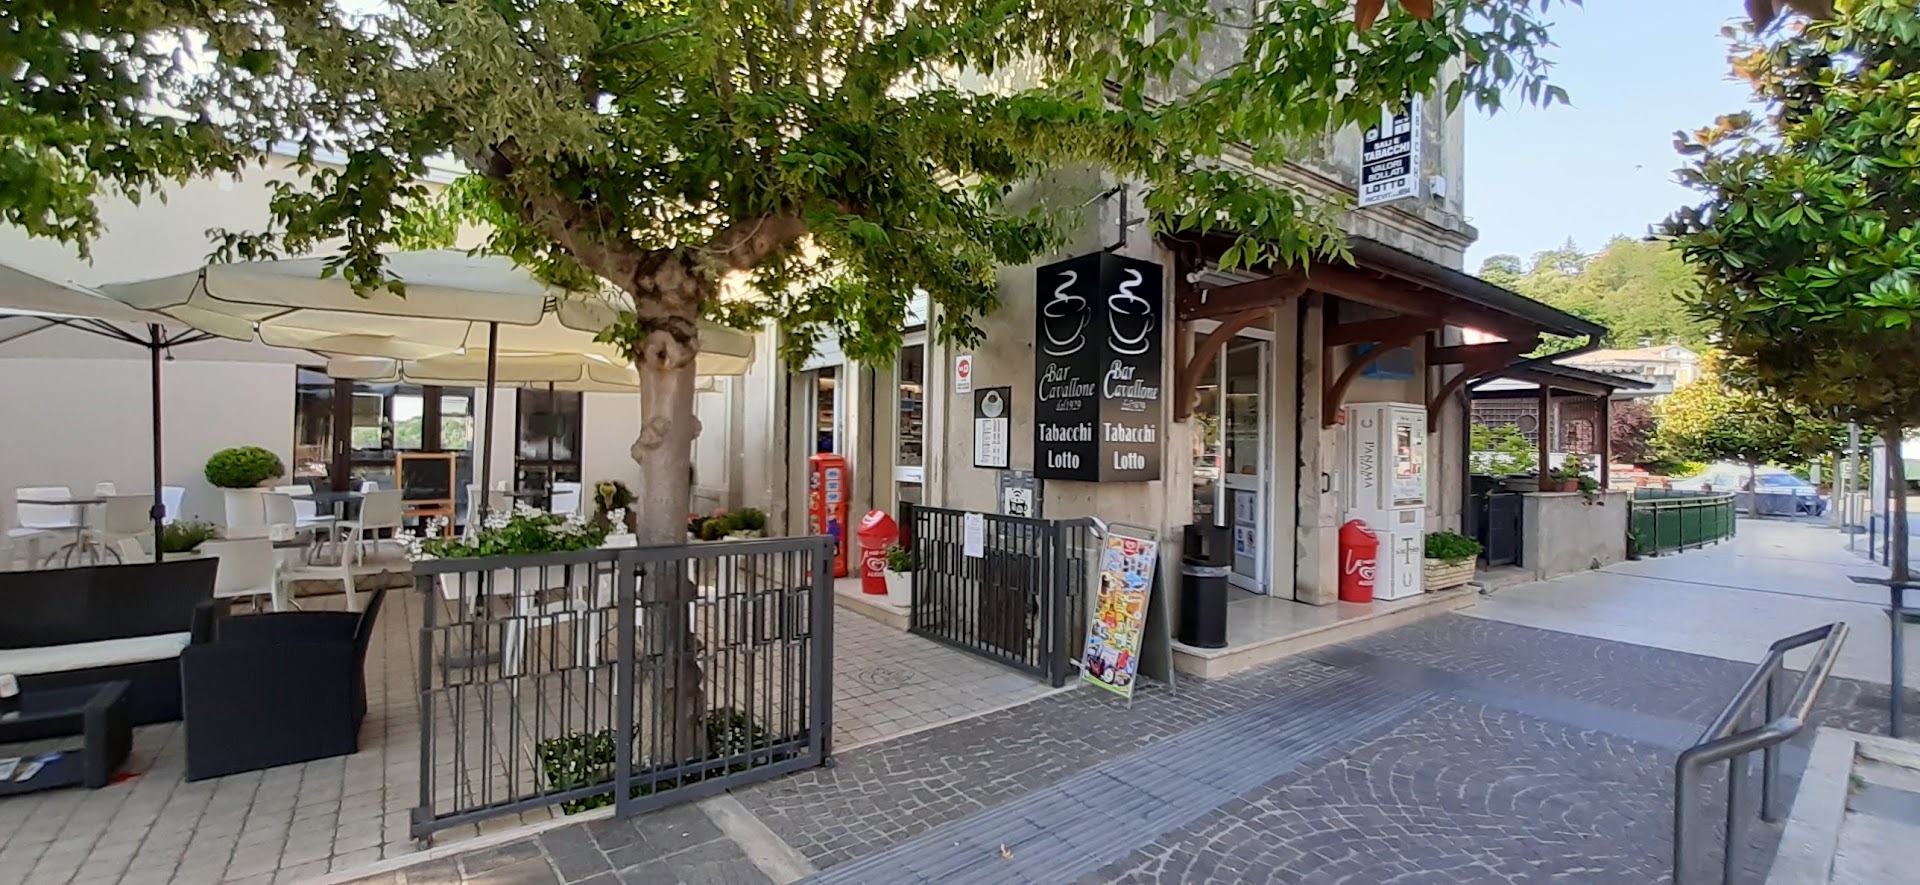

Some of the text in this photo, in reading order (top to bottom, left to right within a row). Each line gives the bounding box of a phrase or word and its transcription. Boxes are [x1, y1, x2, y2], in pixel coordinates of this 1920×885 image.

[1364, 142, 1410, 161] TABACCHI
[1374, 136, 1400, 150] SALI E
[1368, 167, 1404, 182] BOLLATI
[1371, 159, 1402, 173] VALORI
[1366, 179, 1405, 194] LOTTO
[1045, 363, 1071, 383] Bar
[1110, 359, 1136, 381] Bar
[1039, 374, 1096, 402] Cavallone
[1103, 370, 1159, 400] Cavallone
[1038, 422, 1092, 442] Tabacchi
[1103, 423, 1156, 443] Tabacchi
[1048, 450, 1080, 469] Lotto
[1113, 451, 1145, 470] Lotto
